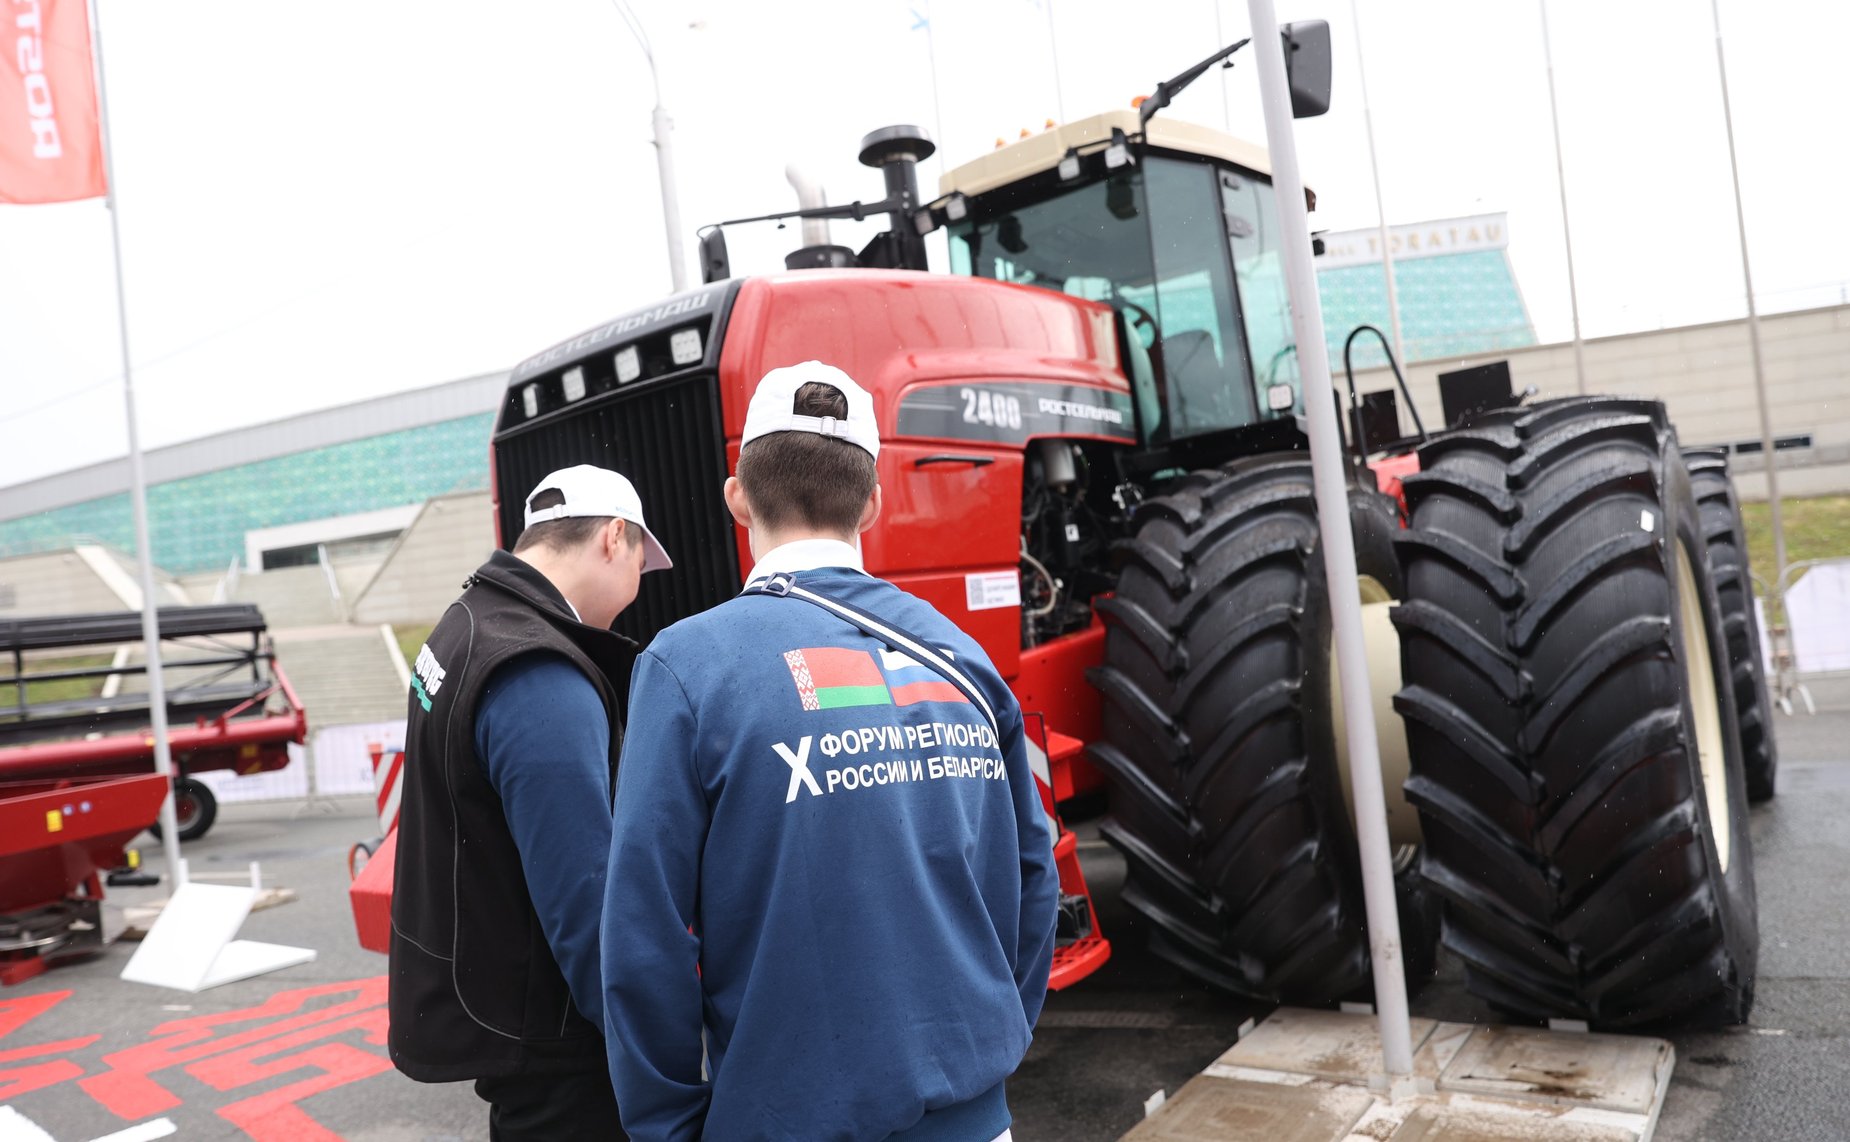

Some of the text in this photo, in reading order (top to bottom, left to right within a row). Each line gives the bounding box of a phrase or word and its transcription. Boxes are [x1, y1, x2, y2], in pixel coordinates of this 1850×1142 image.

[819, 726, 904, 758] ФОРУМ
[826, 760, 909, 793] РОССИИ
[911, 762, 924, 781] И
